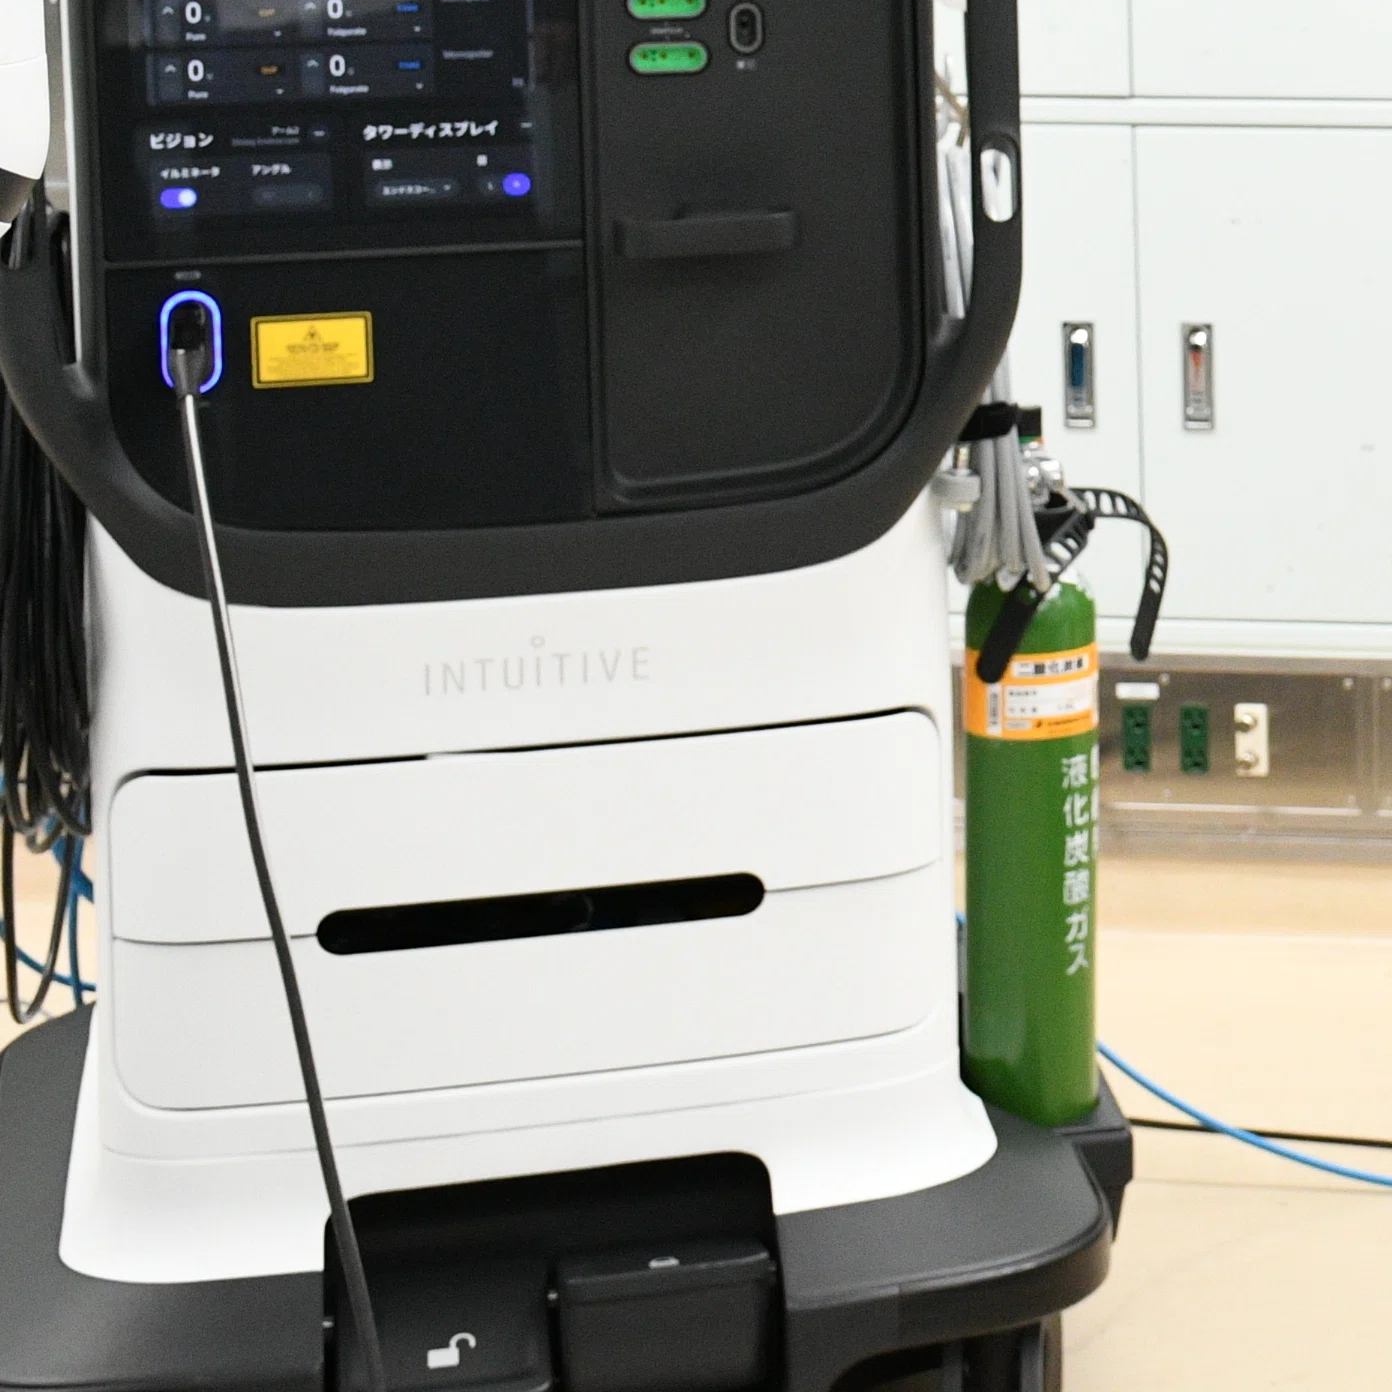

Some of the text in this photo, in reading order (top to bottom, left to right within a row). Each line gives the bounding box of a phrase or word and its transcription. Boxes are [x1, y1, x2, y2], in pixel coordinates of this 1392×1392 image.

[185, 1, 202, 24] 0
[187, 59, 204, 82] 0
[329, 54, 346, 77] 0
[150, 132, 214, 150] ビジョン
[362, 120, 498, 141] タワーディスプレイ
[160, 166, 221, 179] イルミネータ
[251, 163, 292, 176] アングル
[1061, 753, 1090, 976] 液化炭酸ガス
